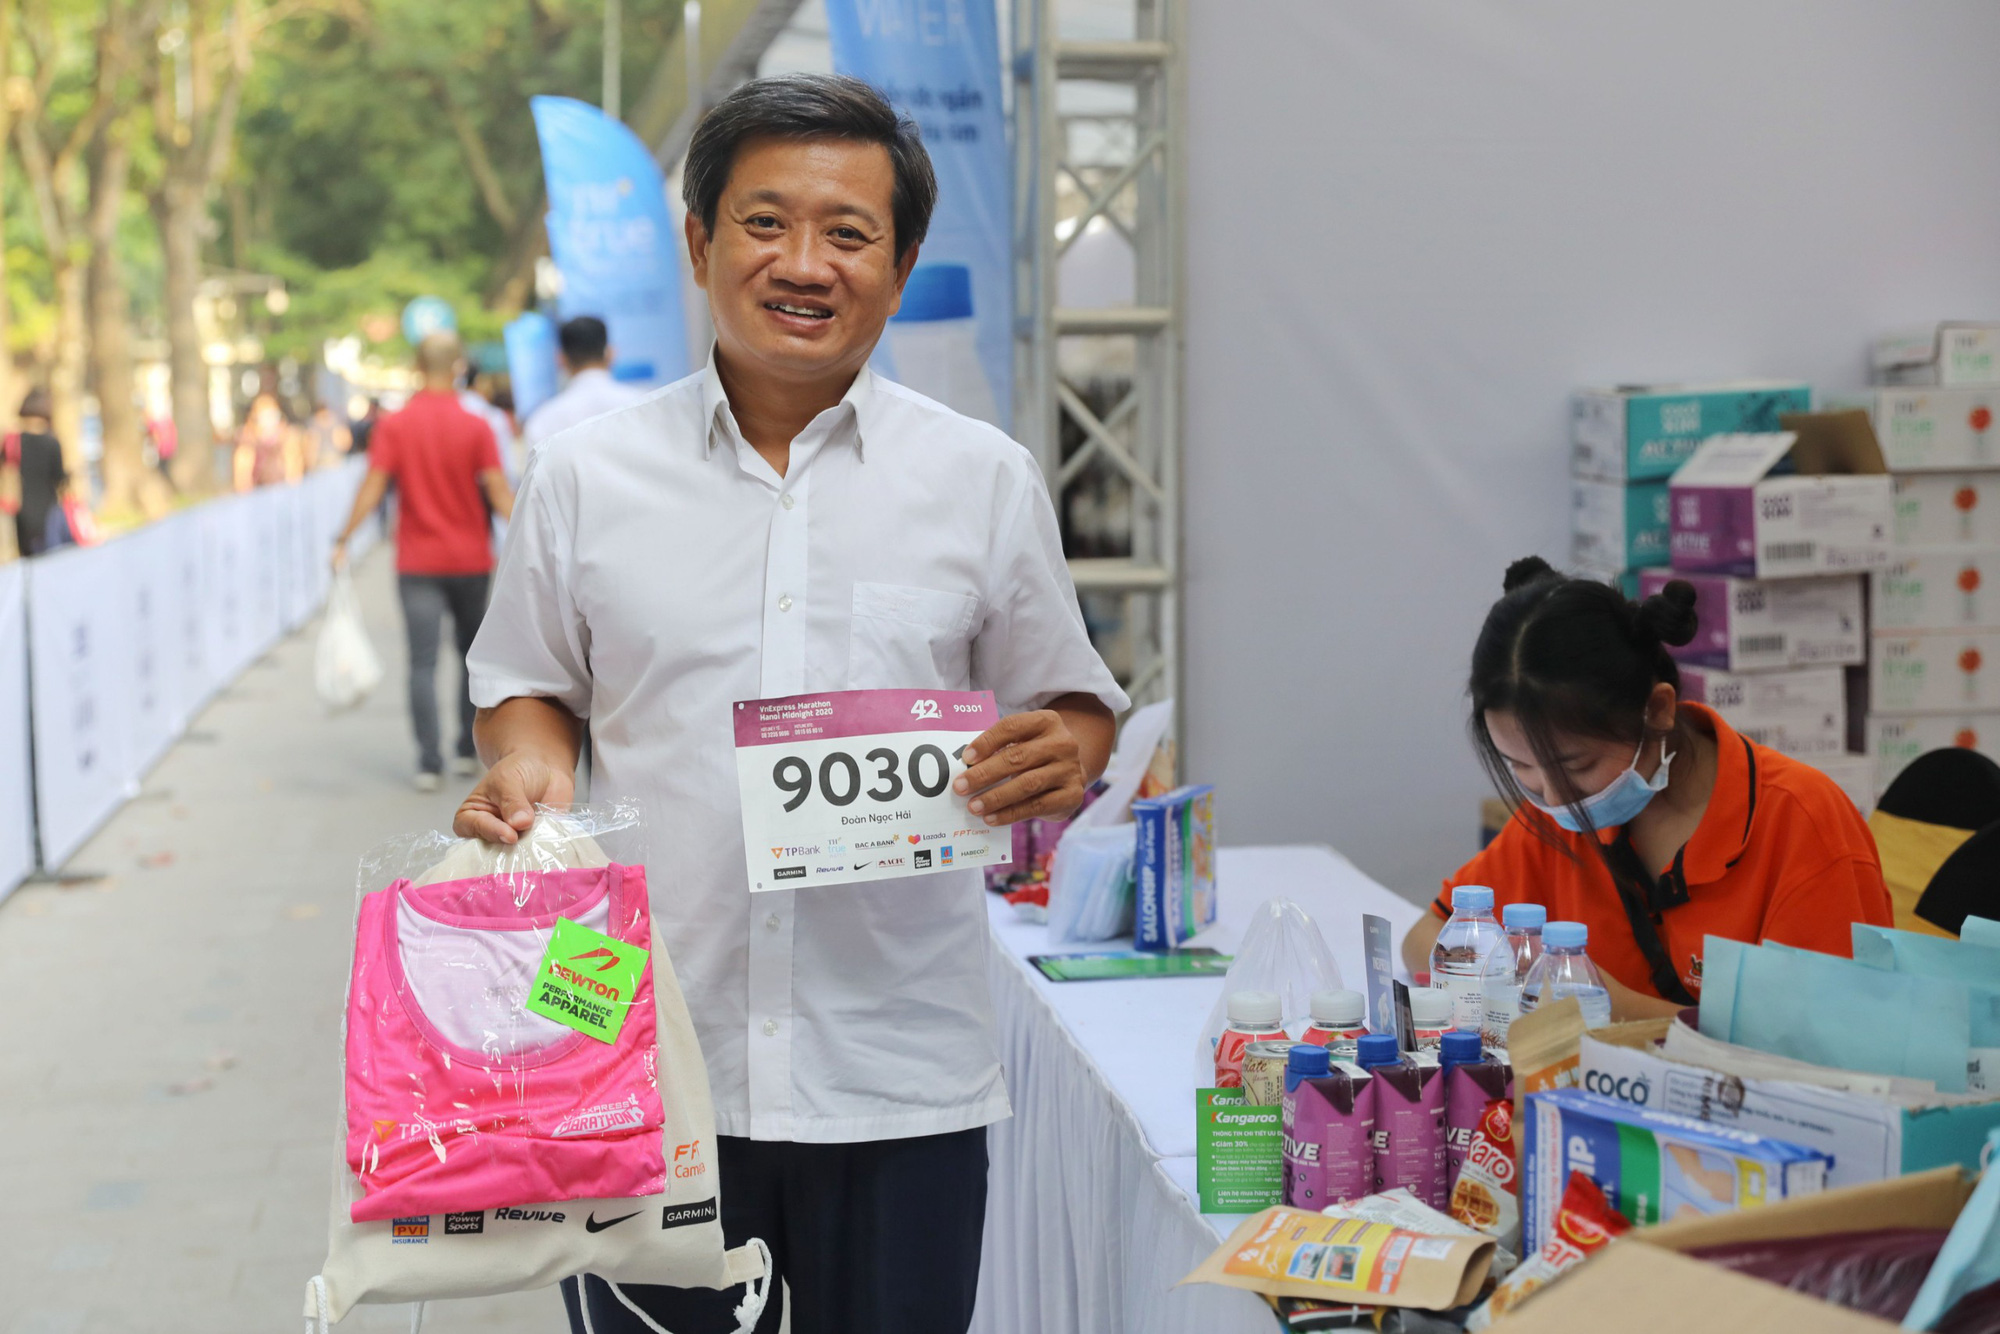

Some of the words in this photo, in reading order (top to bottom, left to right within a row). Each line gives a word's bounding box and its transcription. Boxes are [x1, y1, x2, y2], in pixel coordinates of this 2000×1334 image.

[760, 703, 796, 713] VnExpress
[798, 701, 831, 710] Marathon
[953, 704, 982, 713] 90301
[760, 712, 780, 721] Hanoi
[782, 709, 814, 719] Midnight
[815, 708, 833, 717] 2020
[841, 813, 867, 826] Đoàn
[869, 812, 893, 825] Ngọc
[895, 810, 912, 821] Hải
[923, 832, 946, 841] Lazada
[953, 829, 971, 837] FPT
[877, 839, 895, 847] BANK
[785, 845, 821, 857] TPBank
[961, 848, 985, 857] HABECO
[542, 981, 613, 1018] PERFORMANCE
[539, 992, 607, 1029] APPAREL
[1585, 1069, 1650, 1106] COCO
[1211, 1112, 1277, 1125] Kangaroo
[448, 1215, 481, 1223] Power
[495, 1207, 566, 1223] Revive
[666, 1206, 711, 1221] GARMIN
[397, 1227, 424, 1236] PVI
[448, 1223, 479, 1231] Sports
